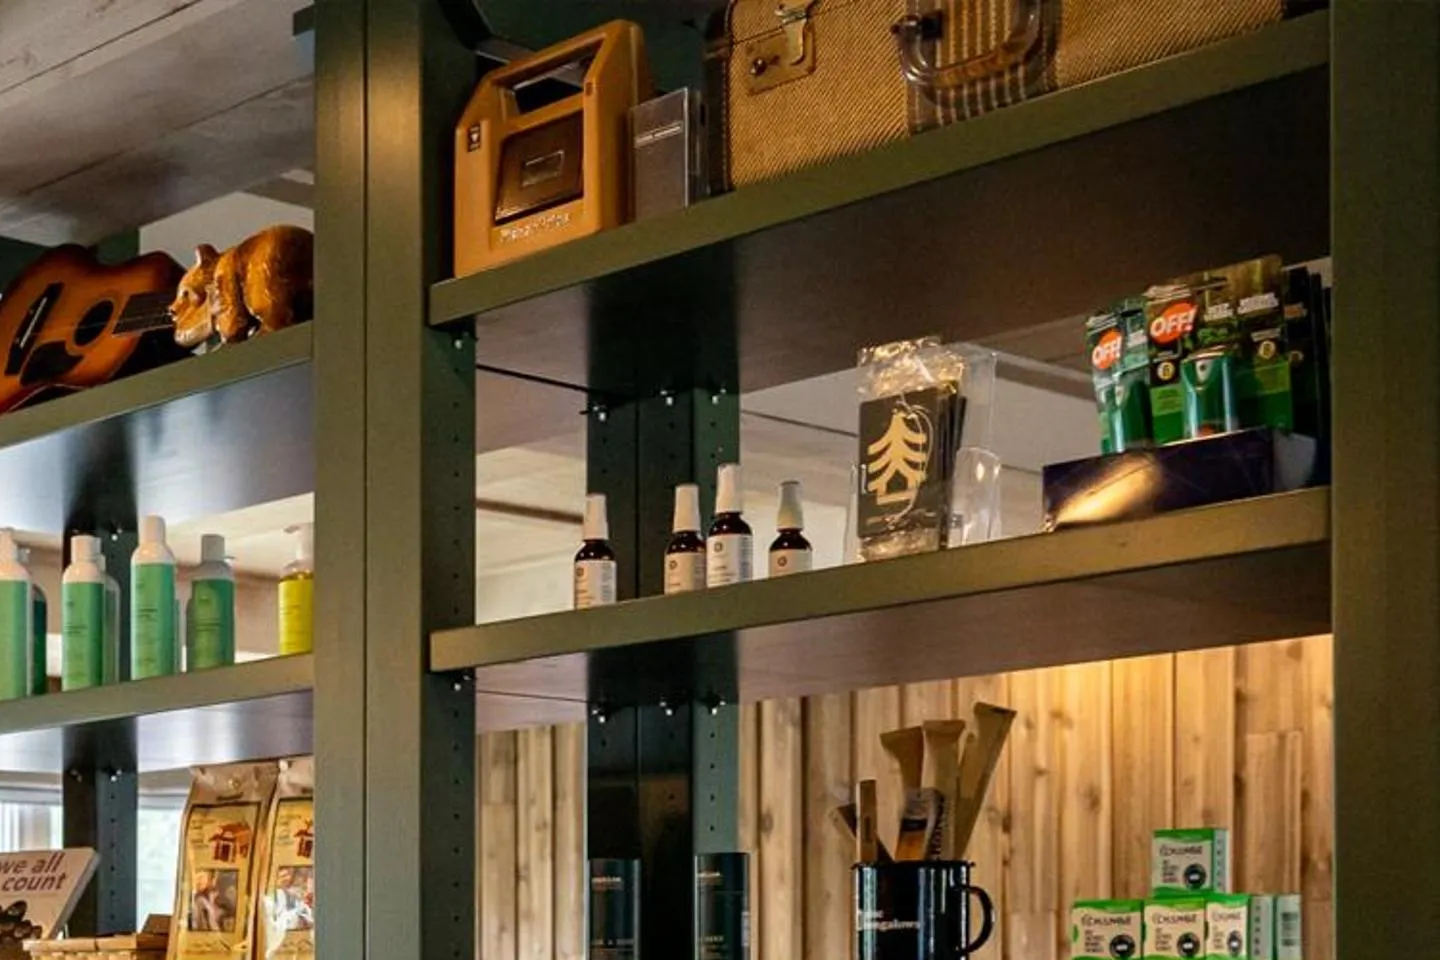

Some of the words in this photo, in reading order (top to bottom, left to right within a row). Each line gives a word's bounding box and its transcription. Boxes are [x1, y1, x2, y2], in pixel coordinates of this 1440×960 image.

[1149, 303, 1198, 338] OFF!
[1091, 335, 1122, 368] OFF!
[31, 852, 66, 873] all
[1, 872, 66, 892] count
